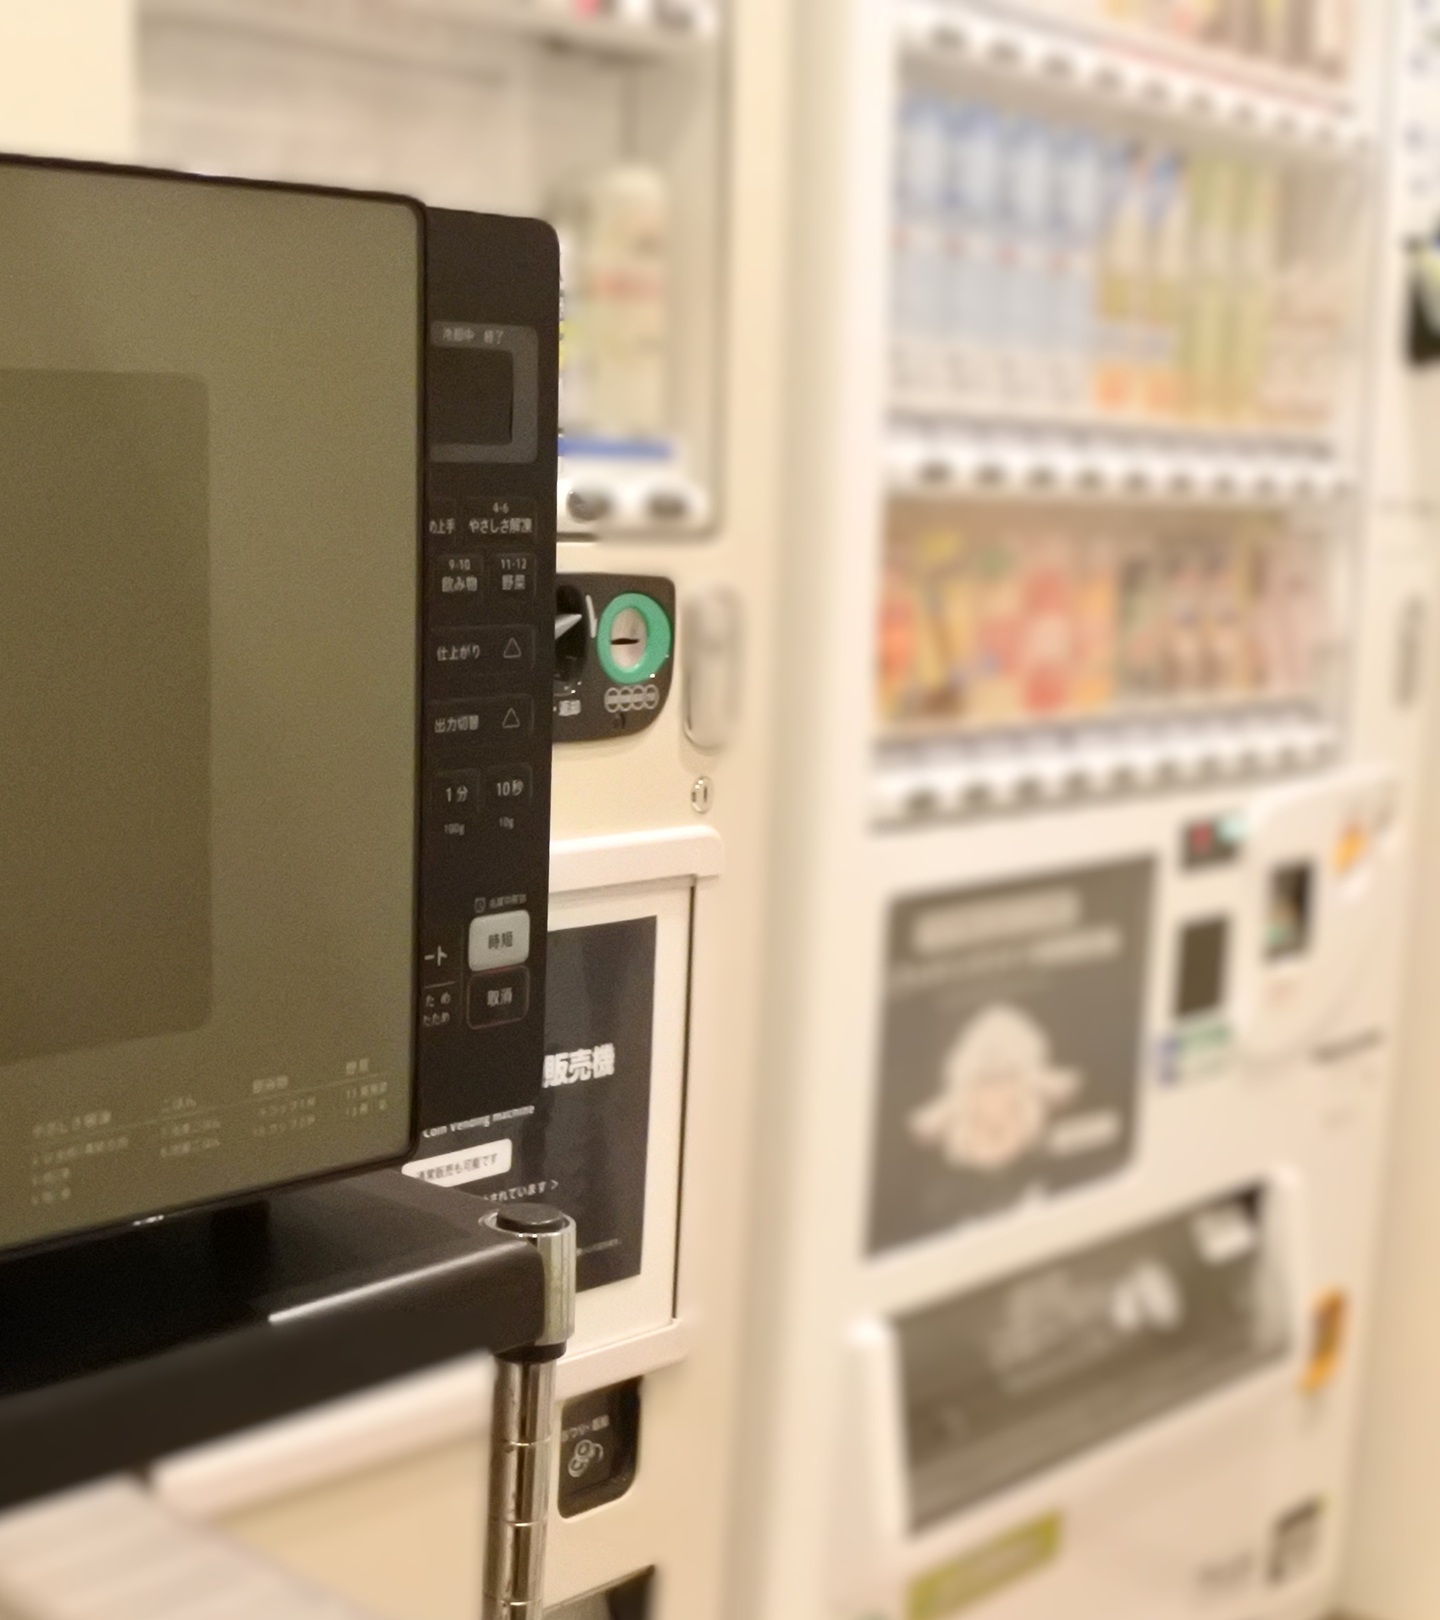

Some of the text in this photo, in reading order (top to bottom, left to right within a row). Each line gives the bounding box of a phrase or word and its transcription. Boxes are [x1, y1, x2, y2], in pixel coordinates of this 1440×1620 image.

[437, 644, 480, 661] 仕上がり
[496, 779, 524, 796] 10秒
[542, 1042, 615, 1088] 販売機
